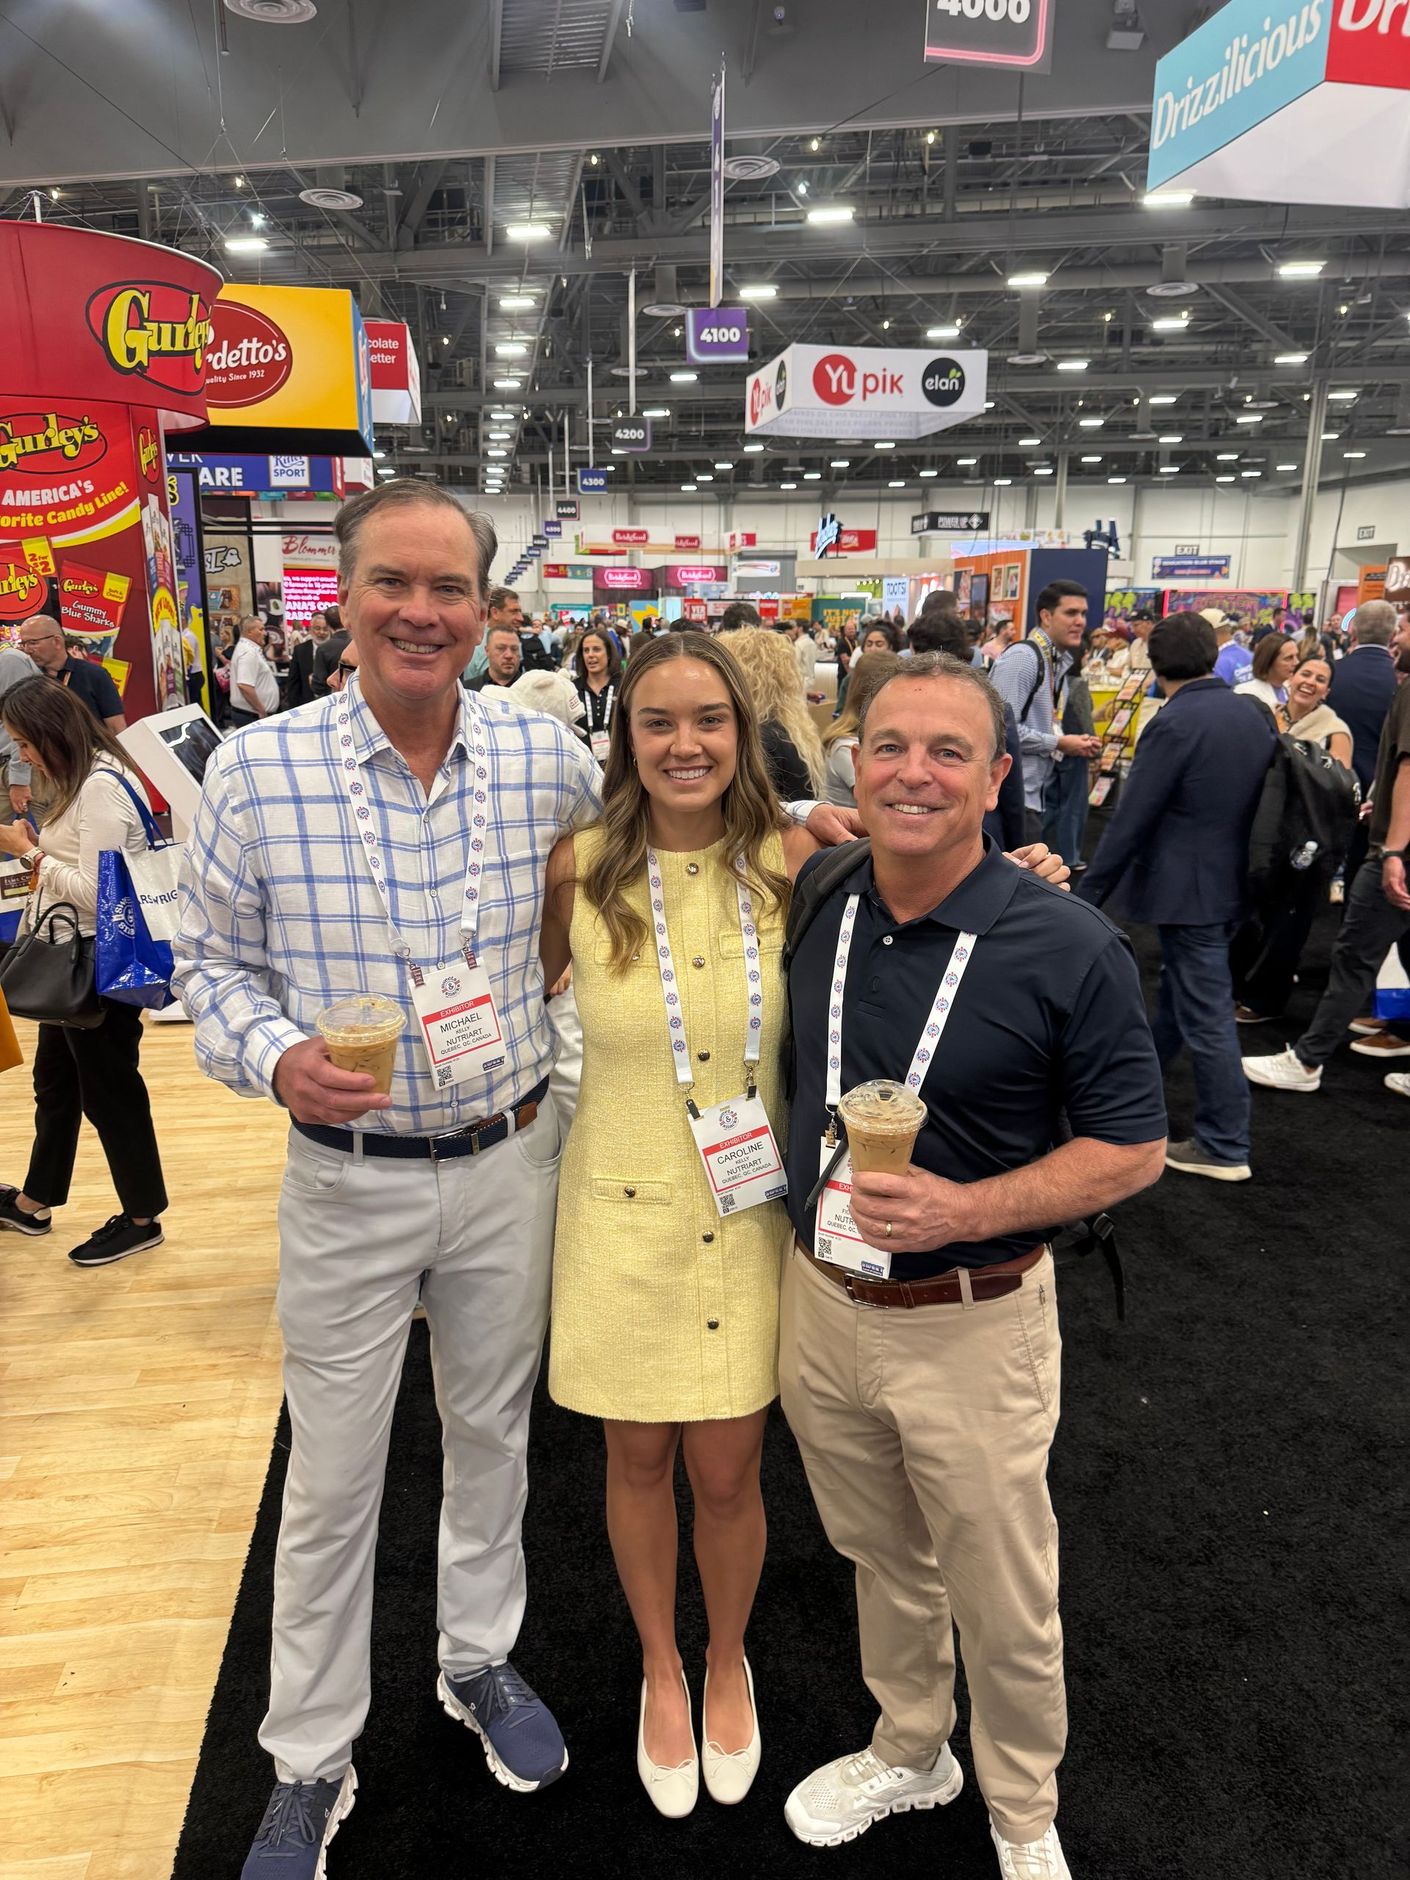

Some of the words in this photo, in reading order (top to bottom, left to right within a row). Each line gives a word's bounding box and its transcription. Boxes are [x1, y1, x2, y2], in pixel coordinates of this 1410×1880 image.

[1151, 0, 1325, 151] Drizzilicious
[700, 327, 741, 343] 4100
[369, 354, 397, 364] etter
[228, 373, 247, 381] Since
[249, 370, 265, 379] 1932
[615, 429, 644, 439] 4200
[273, 469, 306, 477] SPORT
[582, 477, 605, 486] 4300
[46, 502, 96, 525] Candy
[94, 481, 129, 509] Line!
[1176, 545, 1198, 555] EXIT
[61, 606, 82, 619] Blue
[84, 612, 115, 628] Sharks
[73, 600, 107, 619] Gummy
[440, 1001, 475, 1017] EXHIBITOR
[440, 1012, 482, 1033] MICHAEL
[456, 1026, 470, 1034] KELLY
[446, 1028, 483, 1046] NUTRIART
[472, 1033, 492, 1043] CANADA
[720, 1132, 753, 1149] EXHIBITOR
[717, 1141, 764, 1165] CAROLINE
[726, 1158, 762, 1176] NUTRIART
[752, 1162, 772, 1173] CANADA
